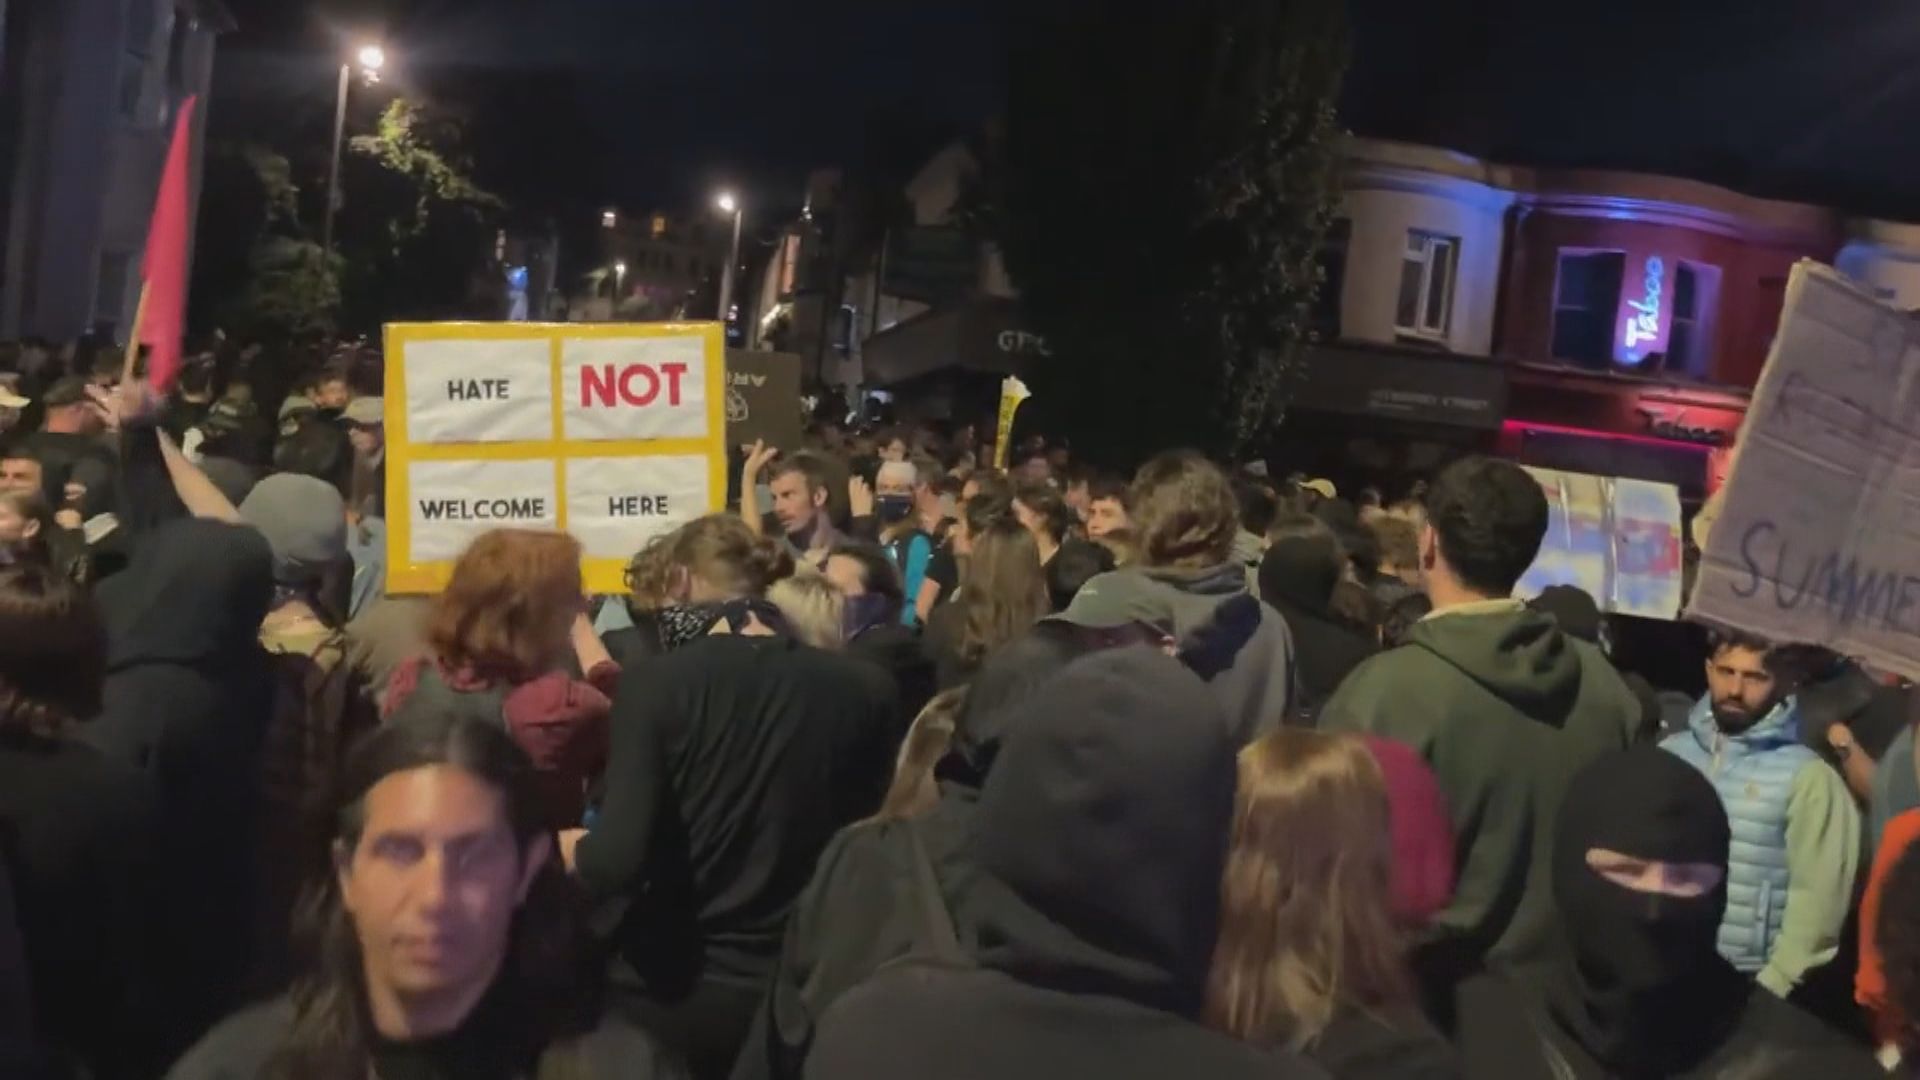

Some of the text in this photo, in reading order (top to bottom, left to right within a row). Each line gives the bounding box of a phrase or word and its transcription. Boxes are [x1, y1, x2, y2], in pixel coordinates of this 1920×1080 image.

[1625, 256, 1663, 347] Taboo
[447, 379, 510, 400] HATE
[580, 362, 688, 408] NOT
[419, 498, 545, 520] WELCOME
[608, 496, 669, 516] HERE
